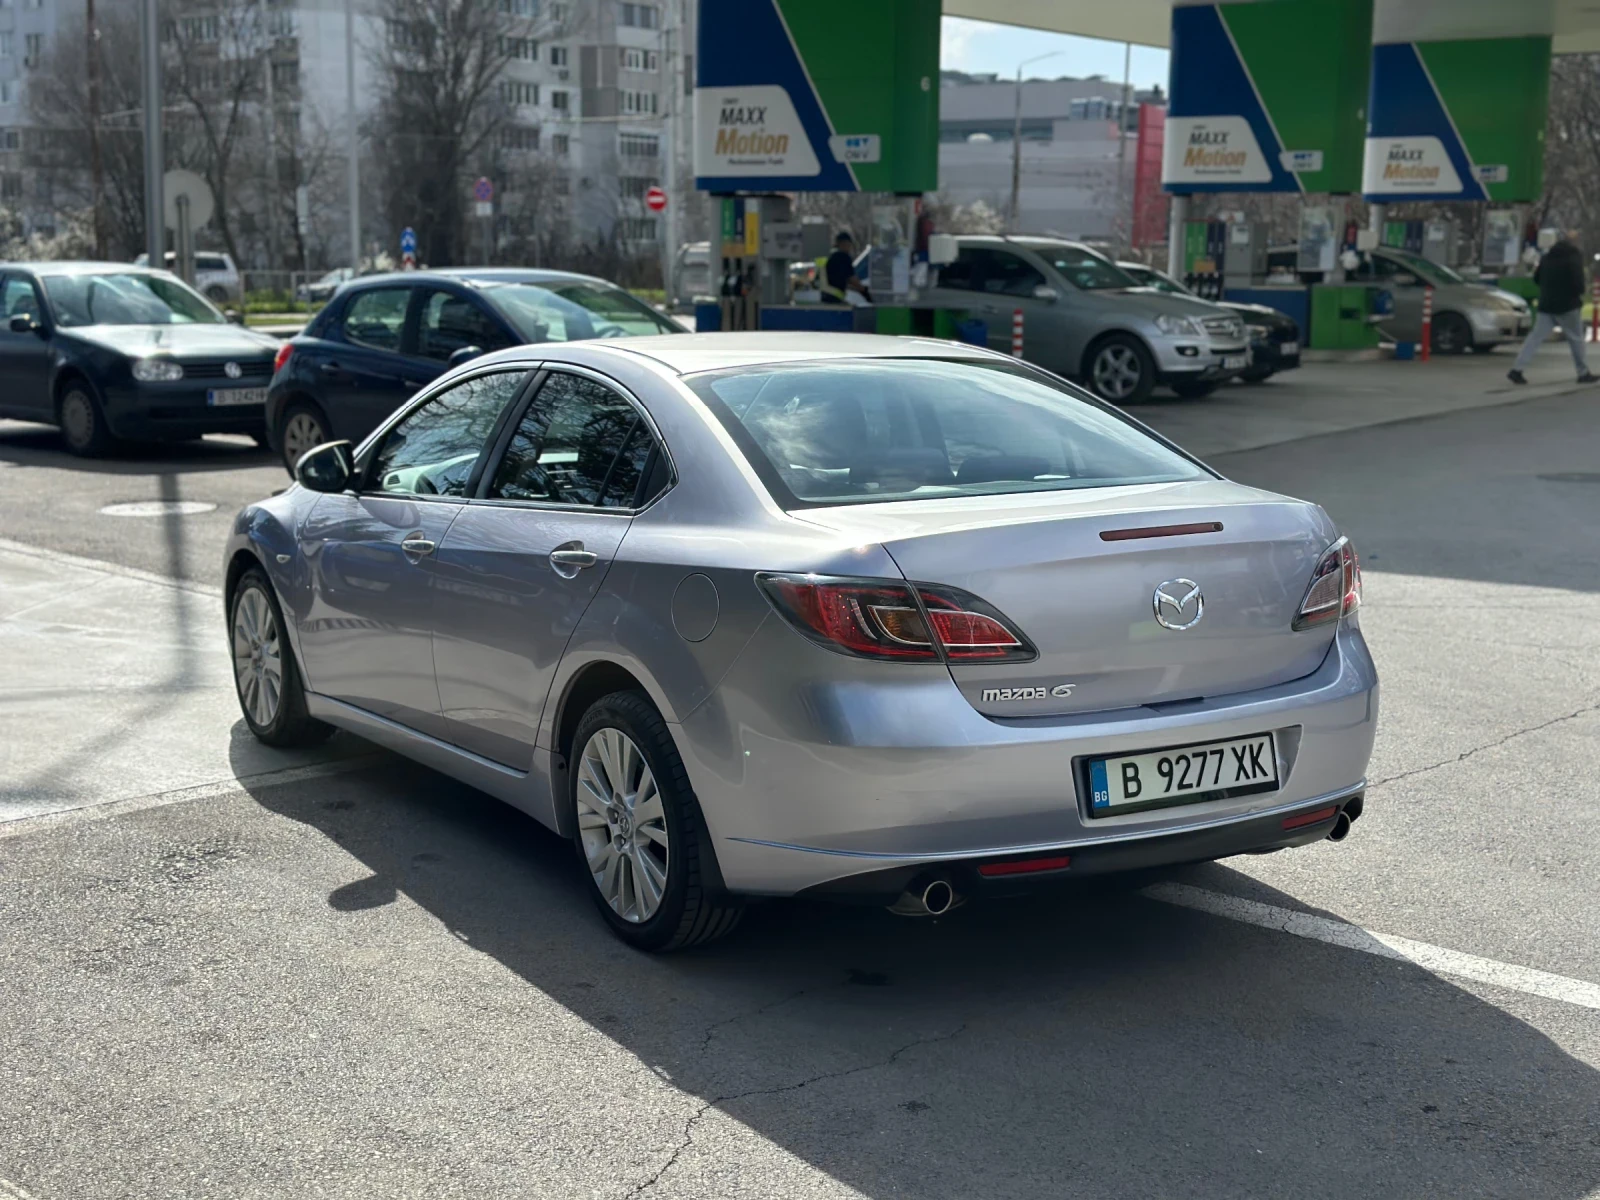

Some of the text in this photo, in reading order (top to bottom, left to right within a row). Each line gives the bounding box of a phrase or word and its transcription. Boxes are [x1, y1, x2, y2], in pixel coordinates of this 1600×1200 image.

[719, 107, 768, 125] MAXX
[715, 129, 789, 156] Motion
[1188, 131, 1230, 145] MAXX
[1184, 147, 1247, 168] Motion
[1387, 149, 1425, 162] MAXX
[1050, 683, 1076, 698] 6
[1121, 742, 1269, 799] B 9277 XK
[1094, 790, 1108, 803] BG
